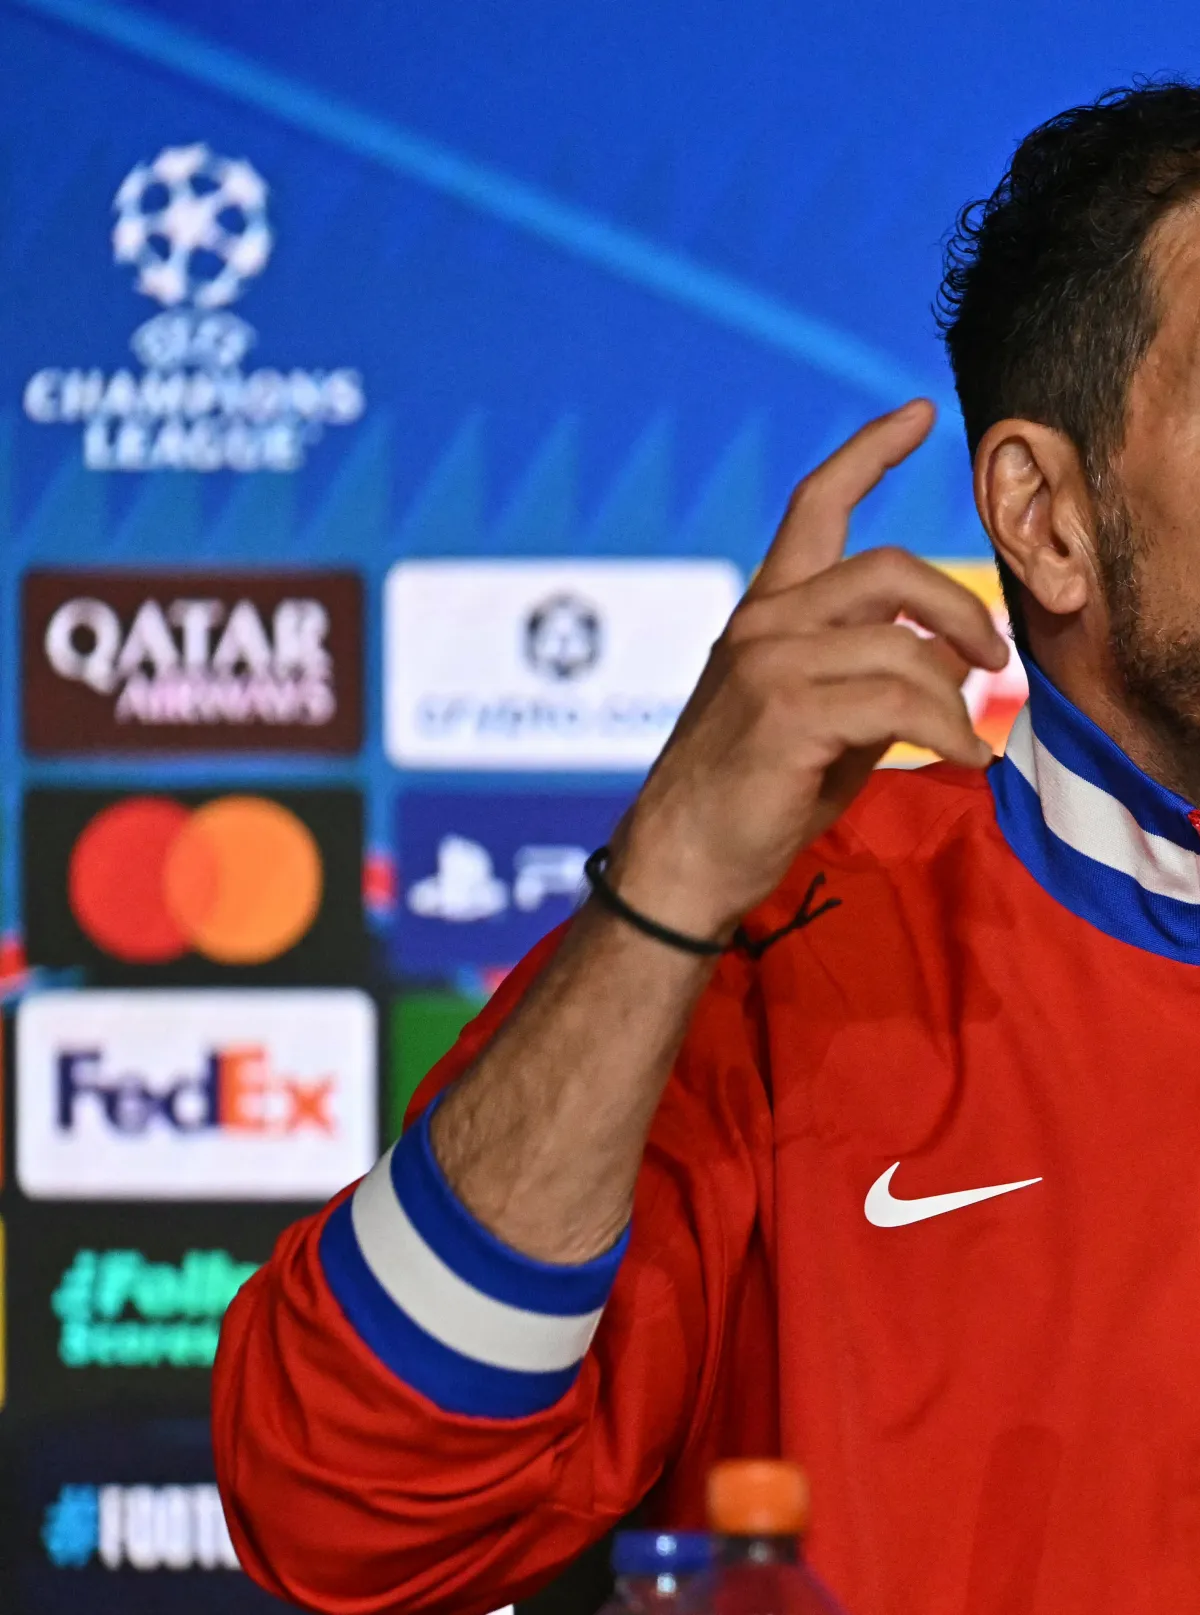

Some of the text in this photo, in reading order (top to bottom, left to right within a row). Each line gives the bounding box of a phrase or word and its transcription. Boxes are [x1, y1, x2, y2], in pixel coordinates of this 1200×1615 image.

[24, 366, 365, 424] CHAMPIONS
[84, 419, 304, 471] LEAGUE
[45, 597, 330, 696] QATAR
[114, 672, 337, 724] AIRWAYS
[57, 1042, 339, 1138] FedEx
